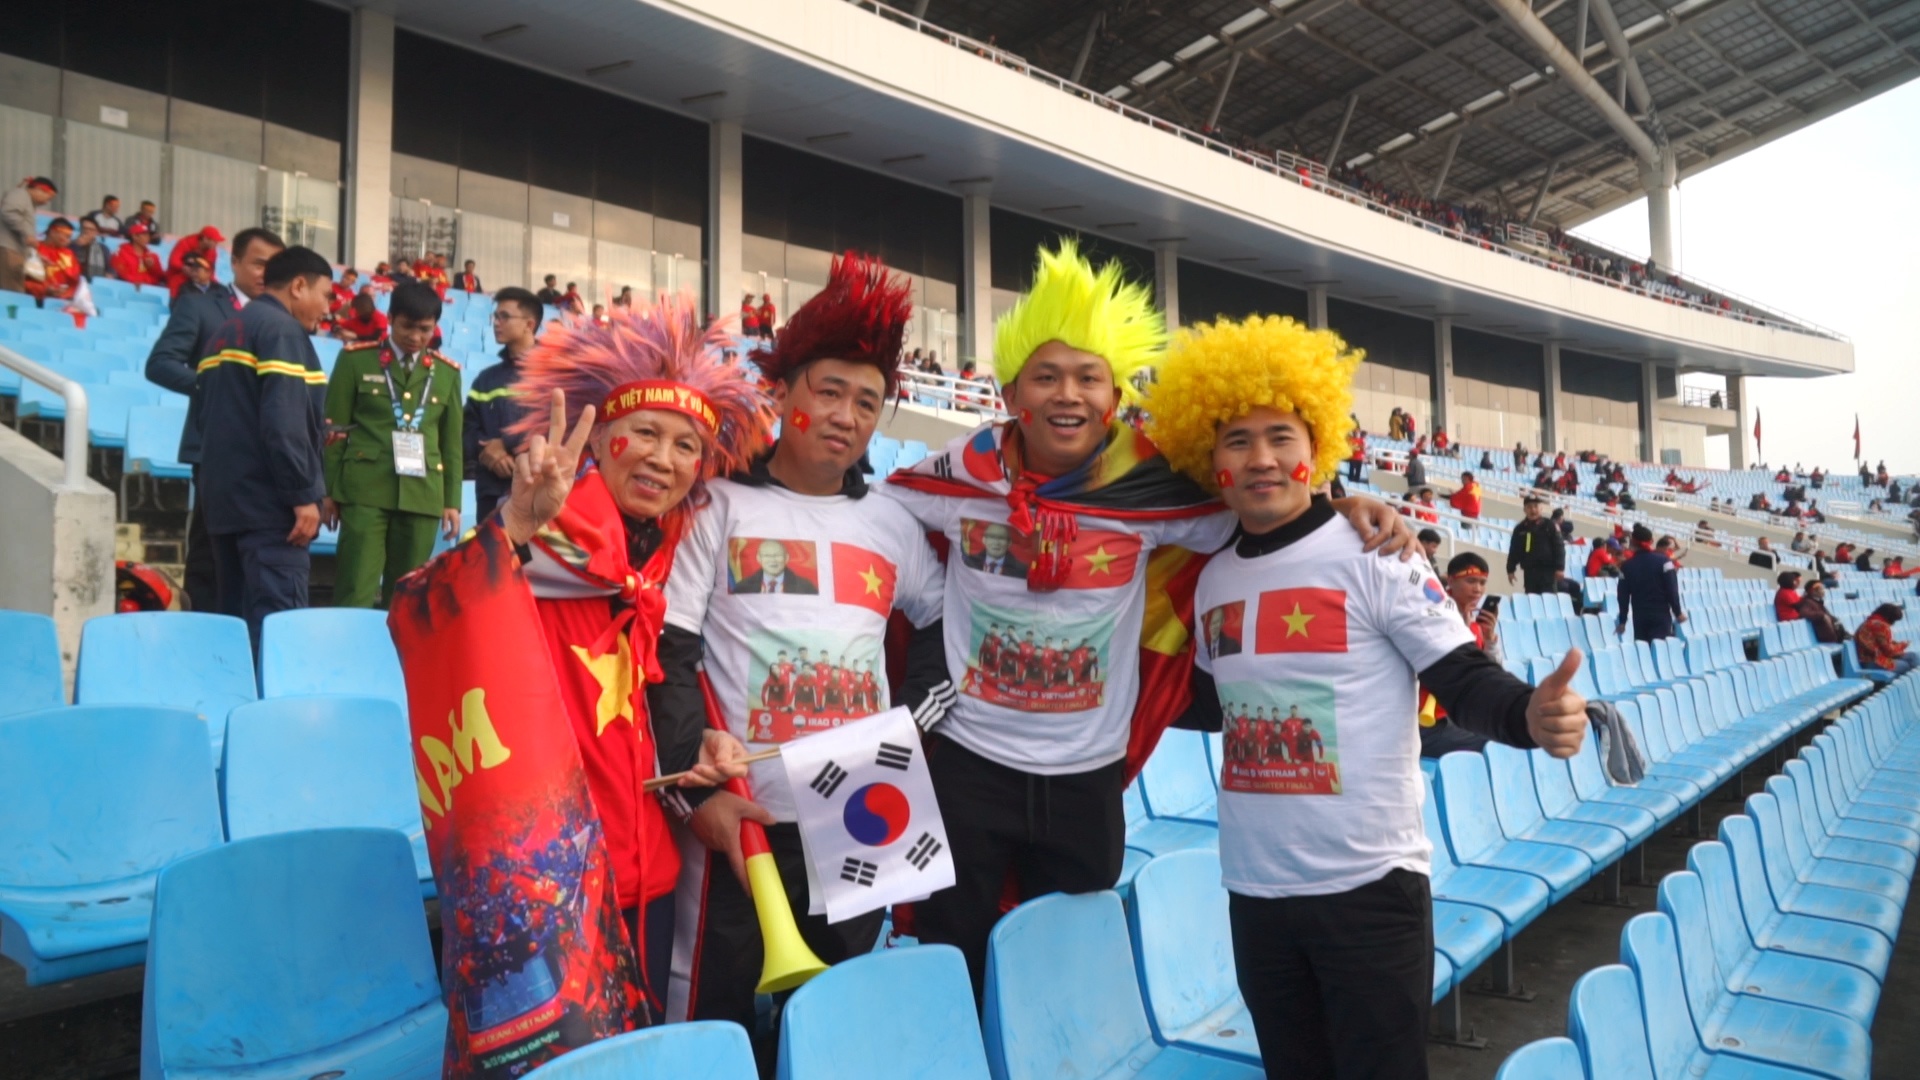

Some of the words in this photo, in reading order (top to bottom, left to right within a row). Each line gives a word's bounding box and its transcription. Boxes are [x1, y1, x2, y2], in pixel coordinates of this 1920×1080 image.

[620, 387, 642, 409] VIỆT
[645, 388, 674, 403] NAM
[1041, 690, 1076, 699] VIETNAM
[1258, 769, 1296, 777] VIETNAM
